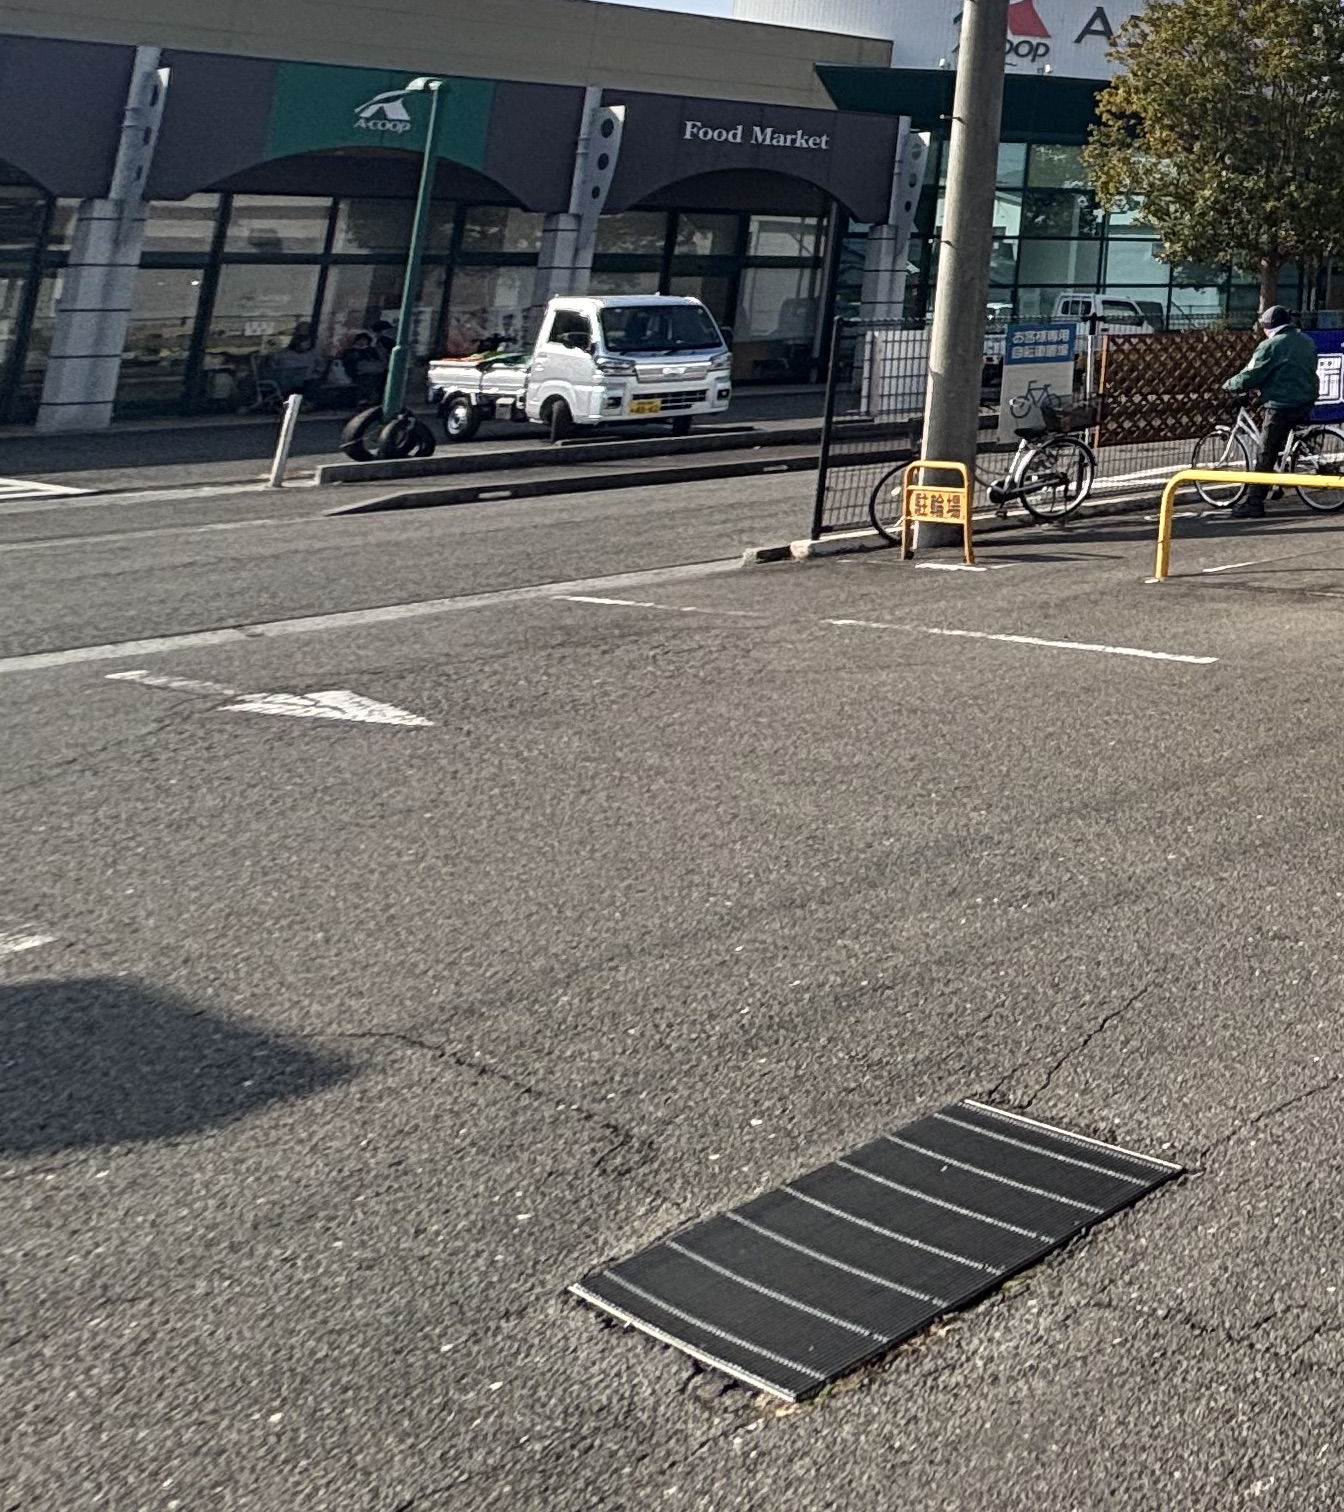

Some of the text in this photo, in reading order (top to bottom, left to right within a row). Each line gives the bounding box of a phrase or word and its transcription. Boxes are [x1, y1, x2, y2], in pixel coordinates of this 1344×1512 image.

[683, 120, 830, 150] Food Market
[914, 492, 962, 518] 駐輪場
